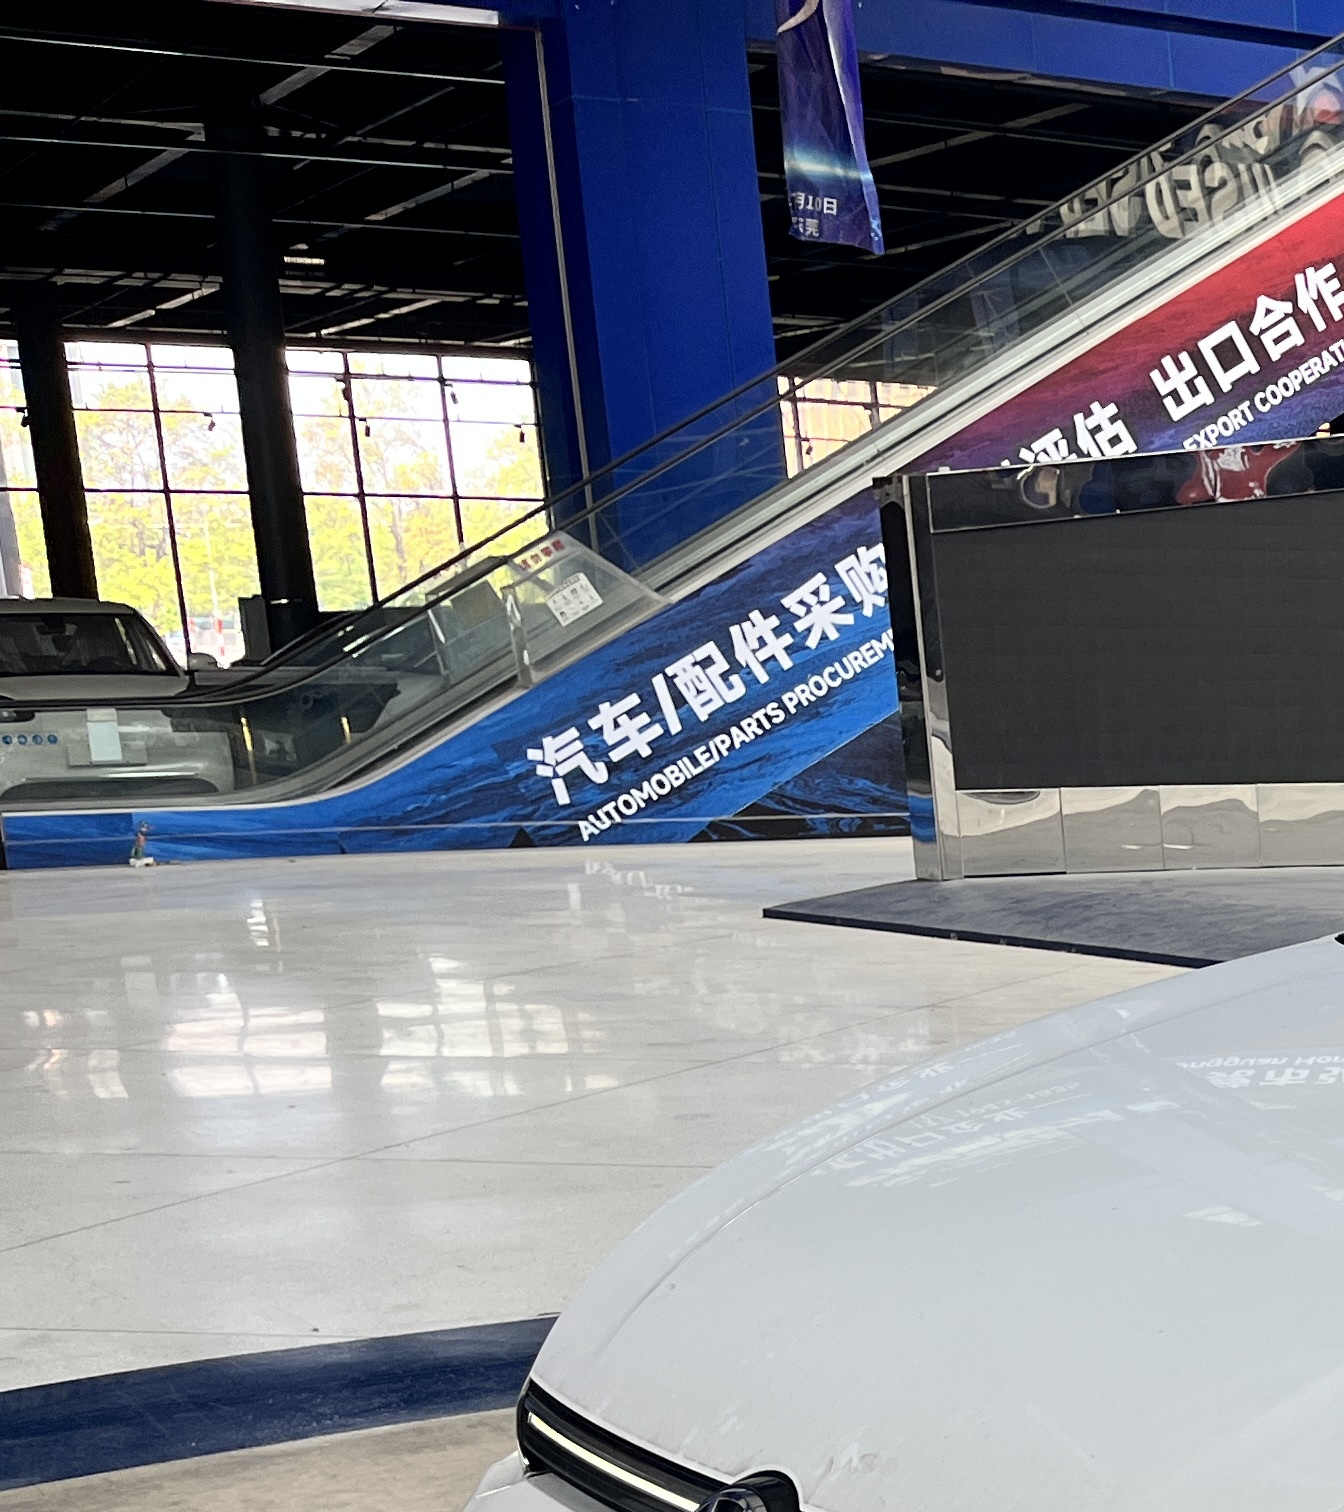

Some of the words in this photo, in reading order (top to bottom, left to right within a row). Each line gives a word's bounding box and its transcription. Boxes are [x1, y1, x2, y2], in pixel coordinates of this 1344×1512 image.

[1000, 400, 1138, 466] 评估
[1182, 400, 1255, 451] EXPORT
[526, 542, 889, 806] 汽车/配件采购
[577, 701, 786, 842] AUTOMOBILE/PARTS
